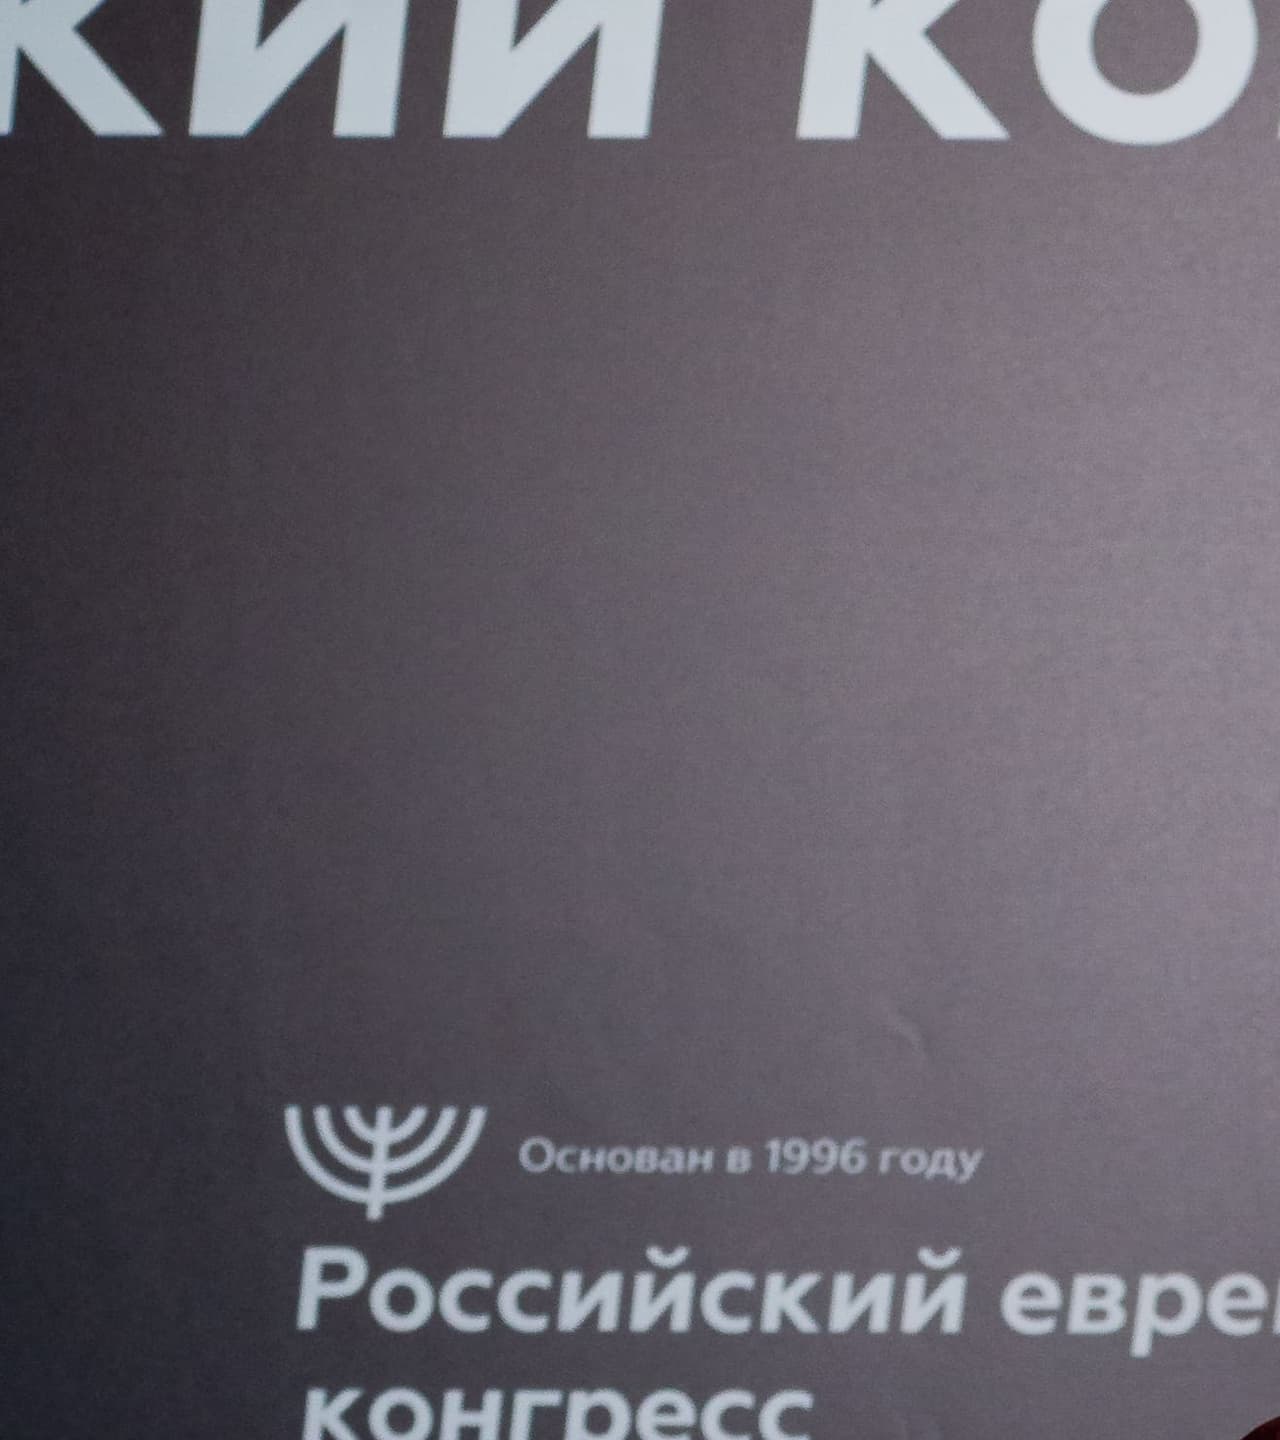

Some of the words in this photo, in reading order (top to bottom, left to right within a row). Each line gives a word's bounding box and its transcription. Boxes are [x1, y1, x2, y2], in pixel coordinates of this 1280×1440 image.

[518, 1136, 713, 1175] Основан
[726, 1146, 752, 1175] в
[765, 1136, 868, 1176] 1996
[879, 1146, 984, 1184] году
[297, 1244, 967, 1334] Российский
